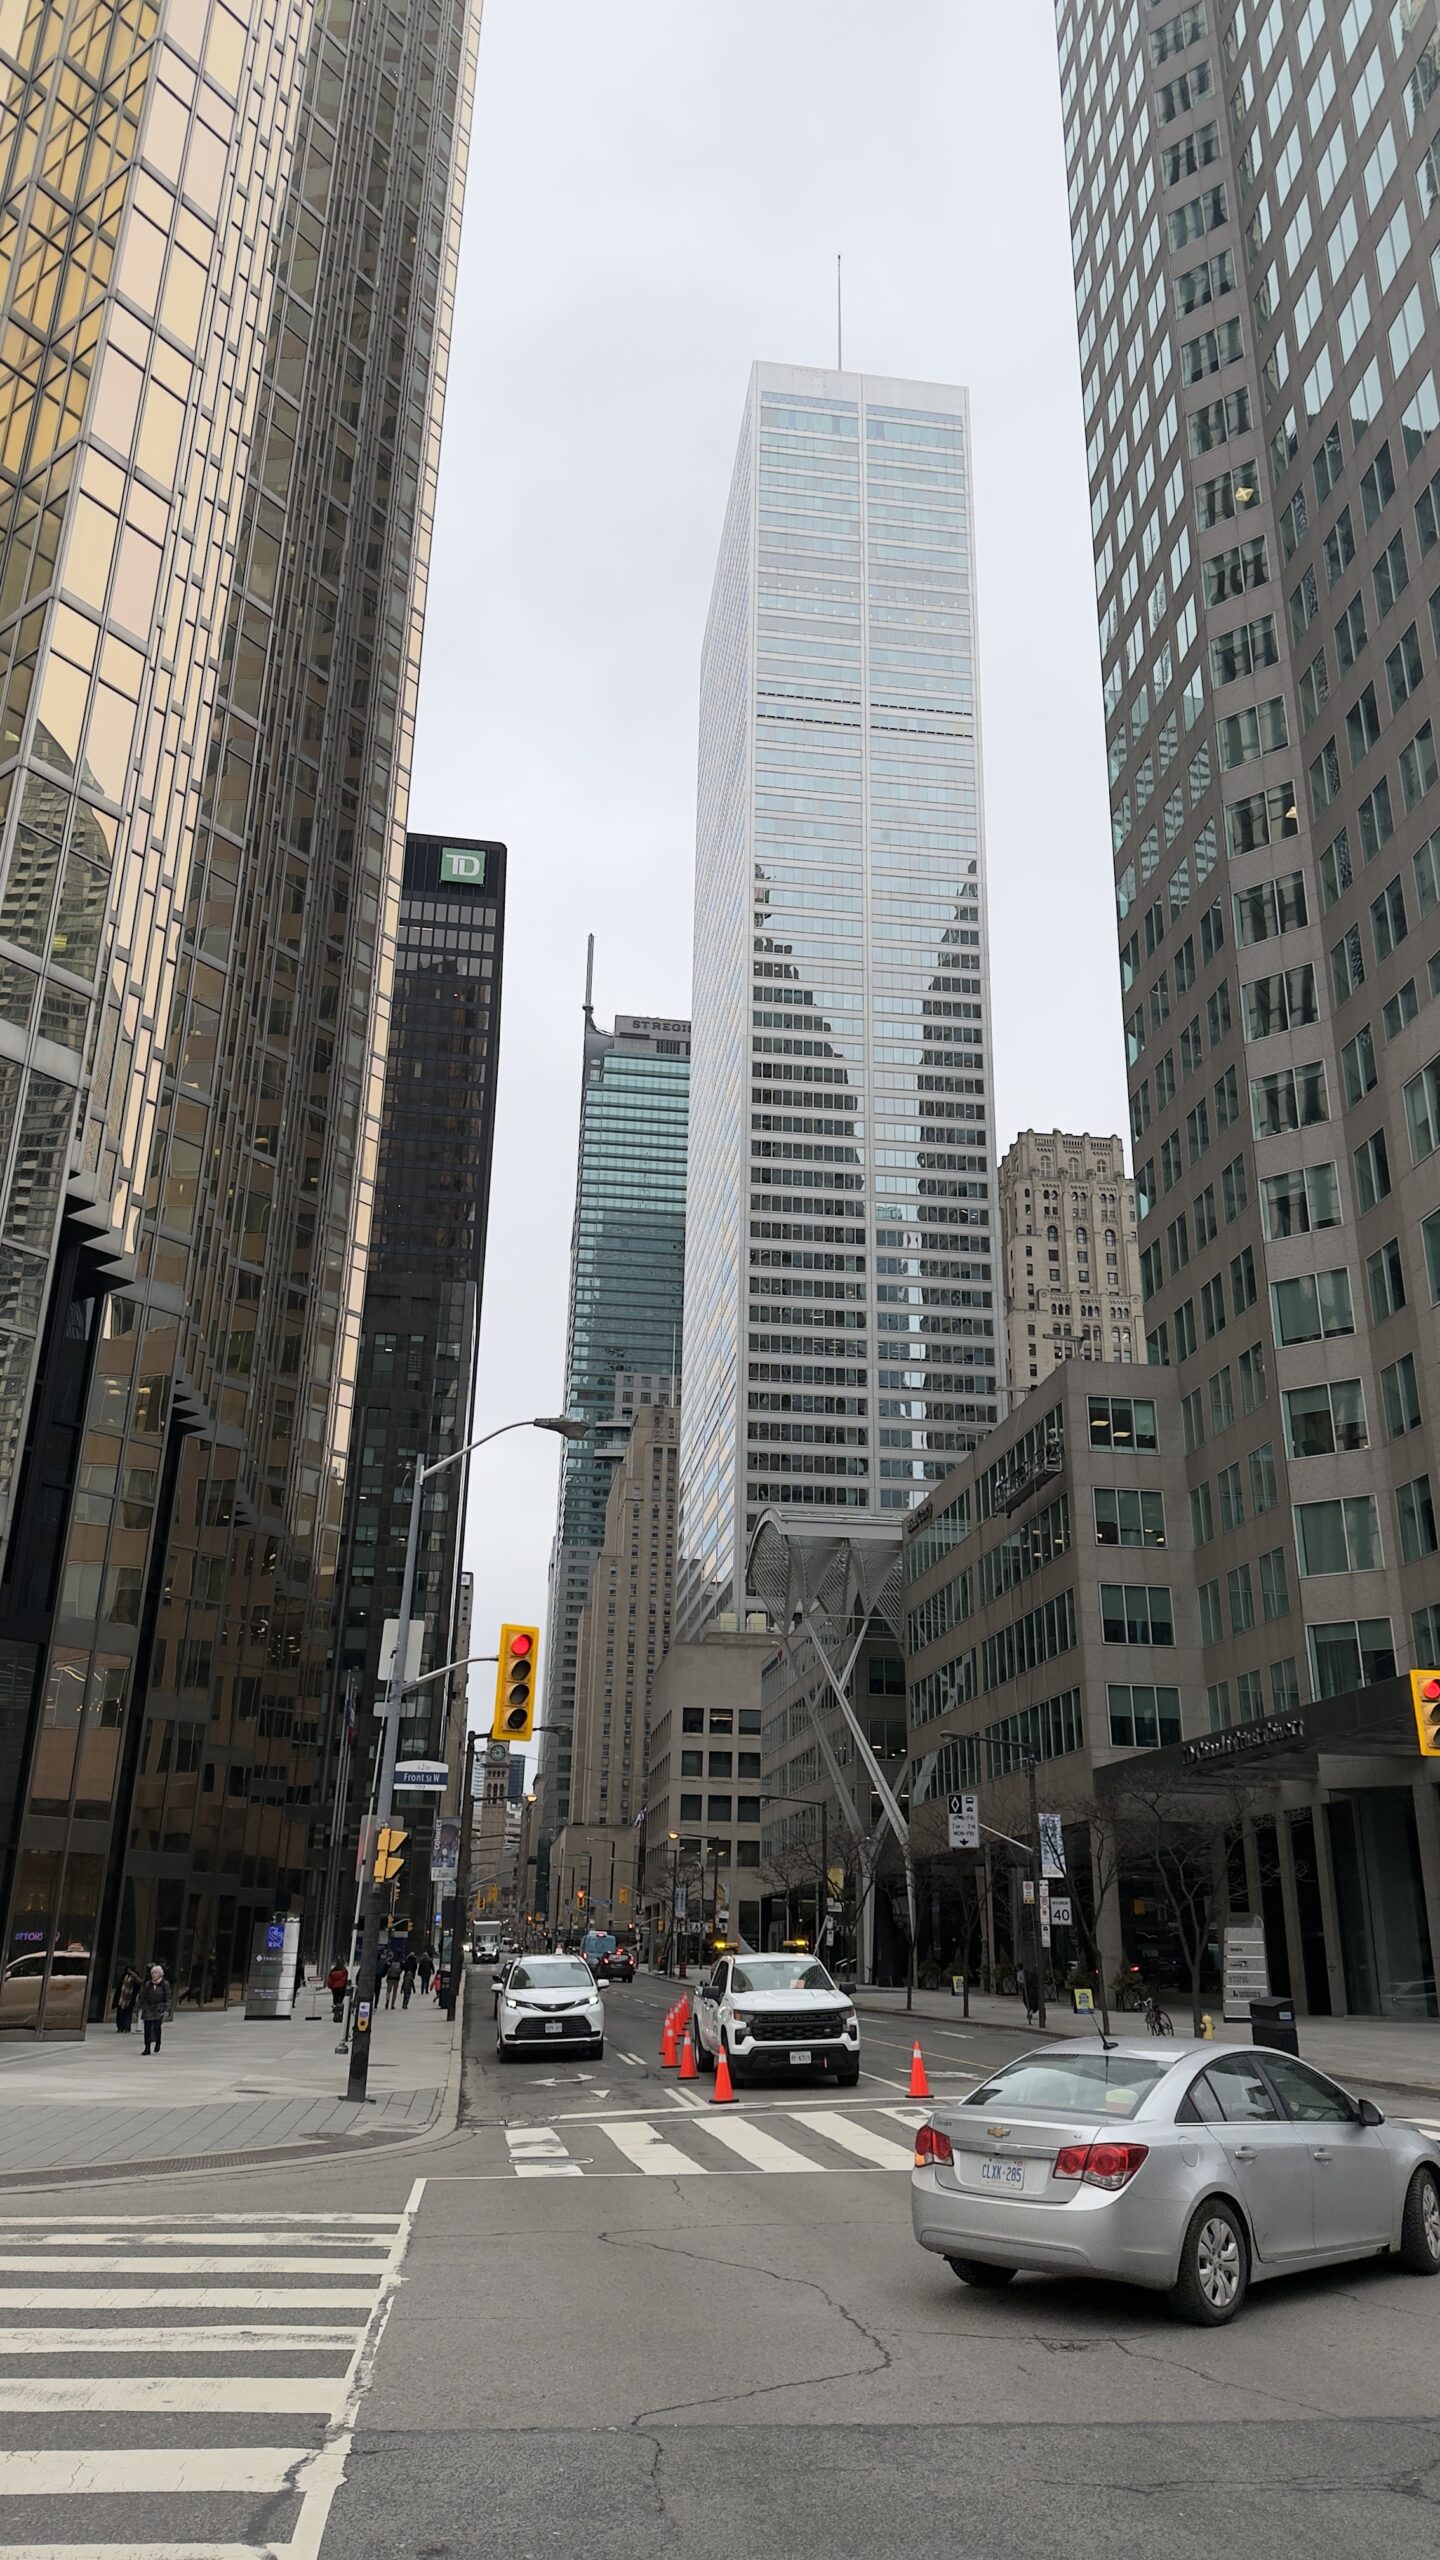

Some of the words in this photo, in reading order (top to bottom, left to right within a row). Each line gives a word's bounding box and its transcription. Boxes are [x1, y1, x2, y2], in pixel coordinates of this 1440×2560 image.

[446, 853, 481, 877] TD
[403, 1772, 425, 1783] Front
[433, 1773, 440, 1782] W
[1053, 1909, 1070, 1921] 40
